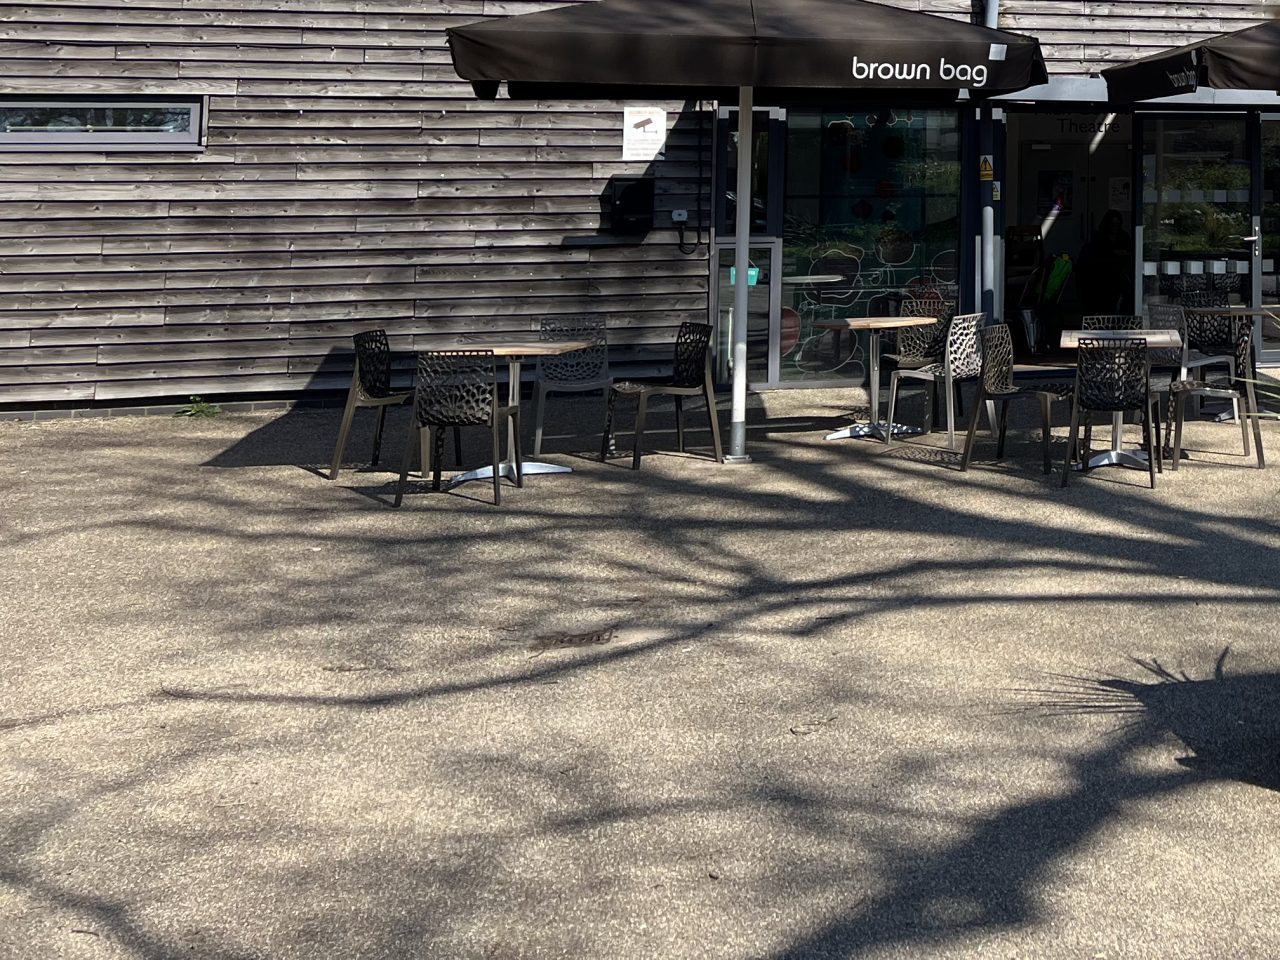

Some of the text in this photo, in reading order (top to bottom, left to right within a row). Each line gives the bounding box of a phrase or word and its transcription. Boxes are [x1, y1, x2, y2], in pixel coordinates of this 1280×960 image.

[852, 56, 988, 87] brown bag
[1057, 118, 1120, 133] Theatre
